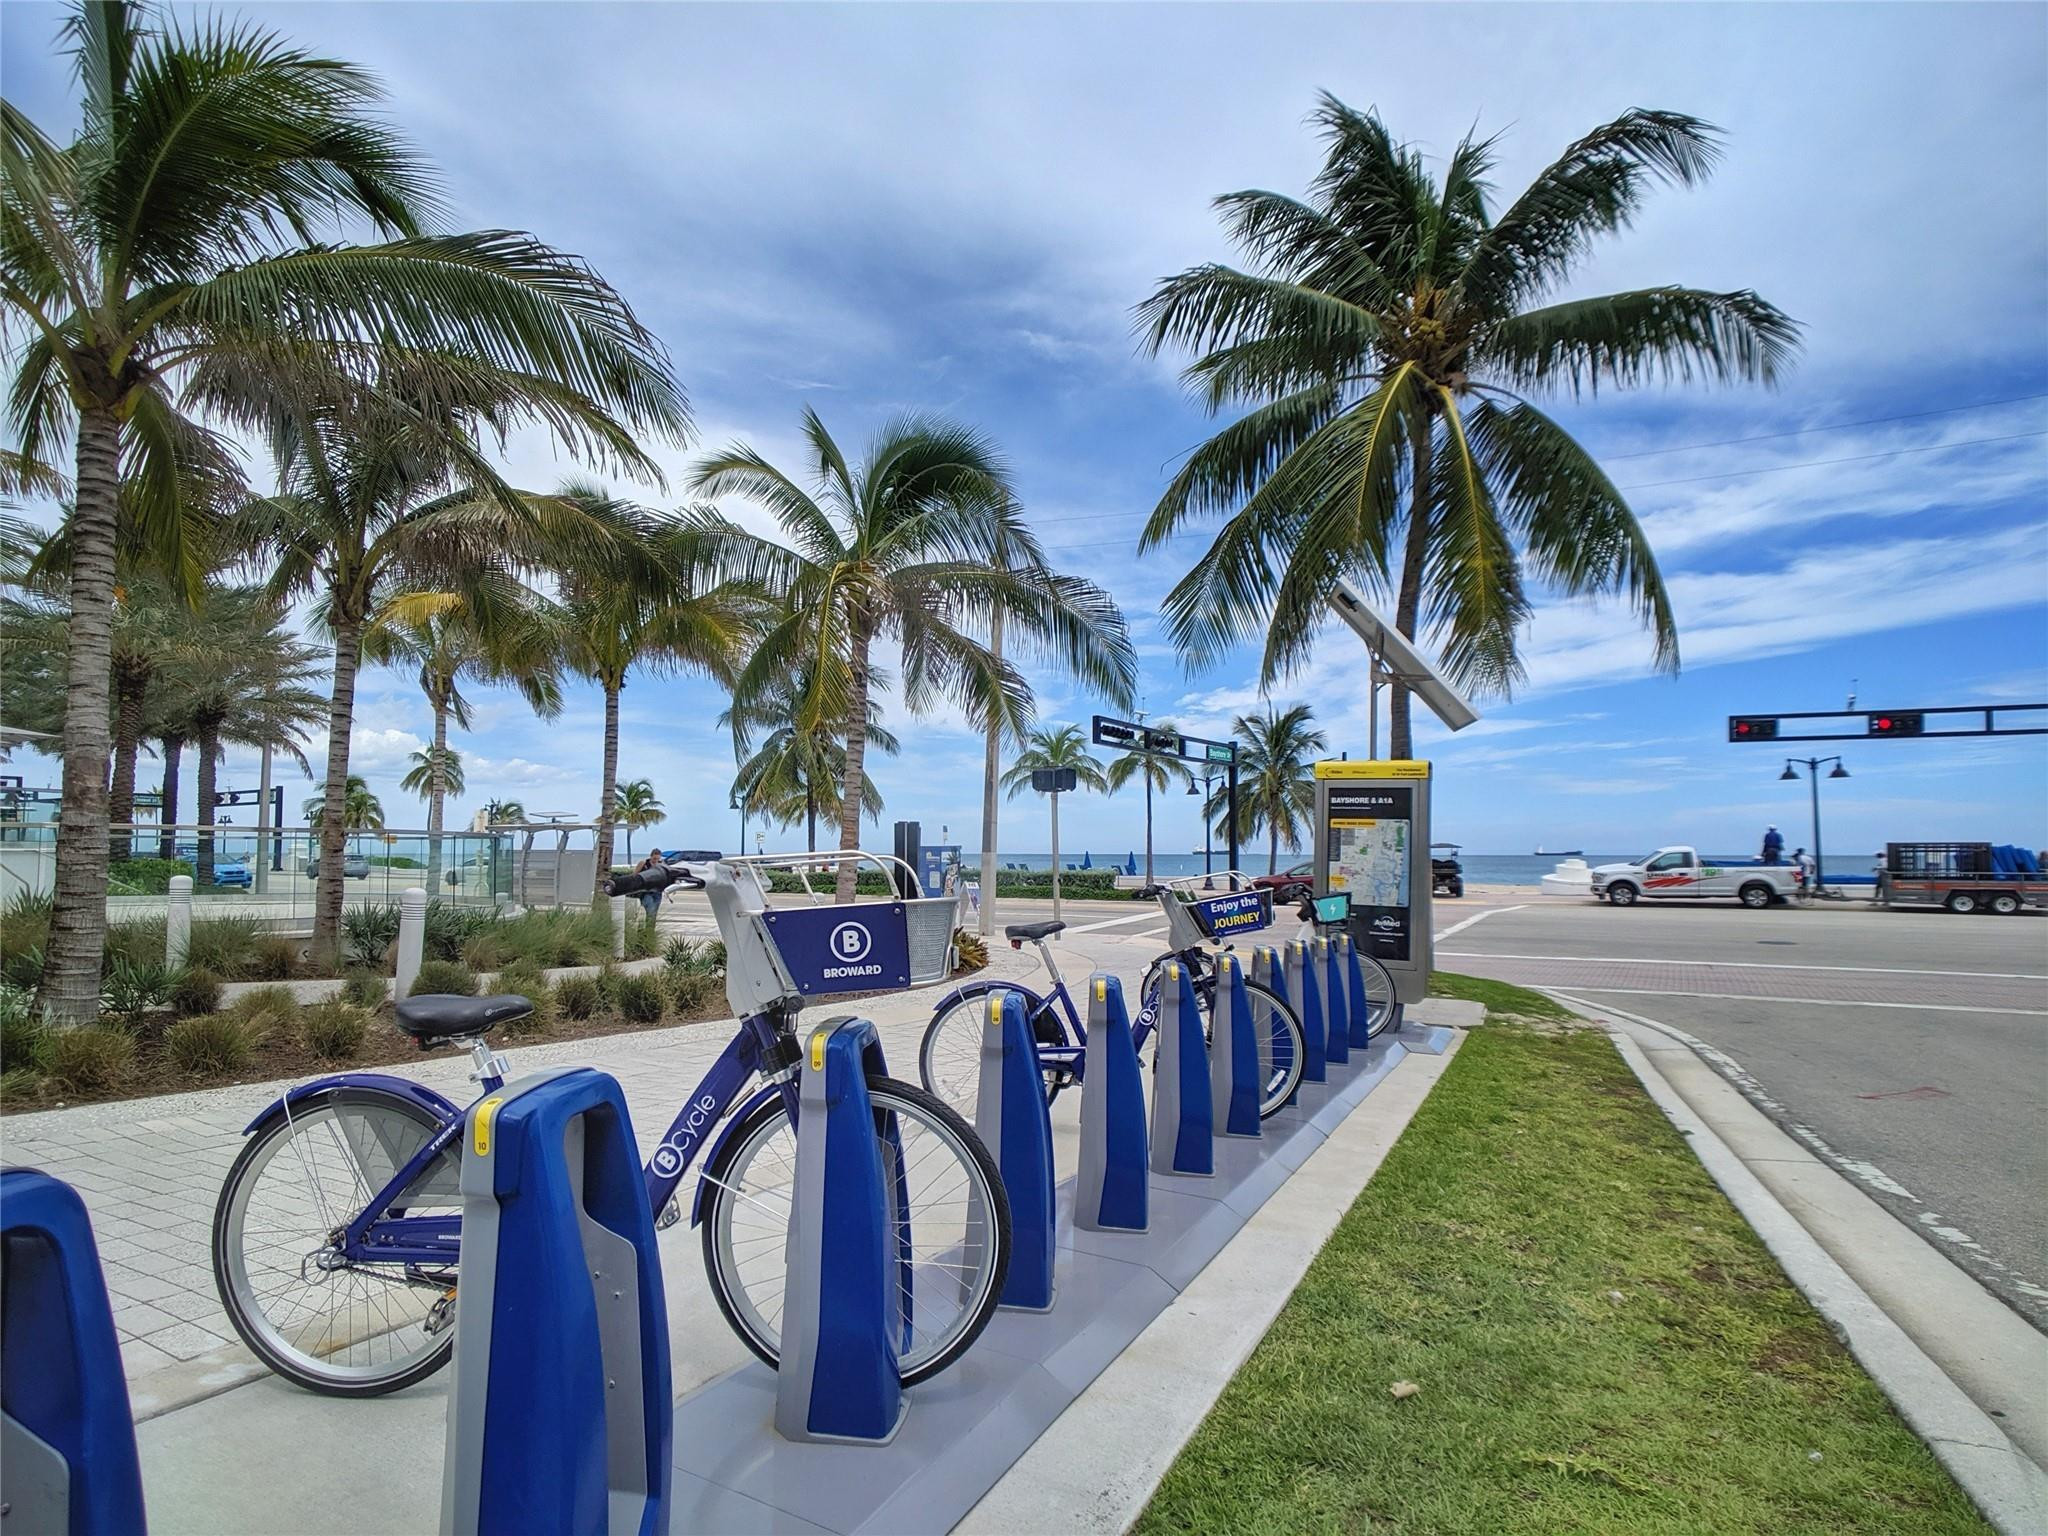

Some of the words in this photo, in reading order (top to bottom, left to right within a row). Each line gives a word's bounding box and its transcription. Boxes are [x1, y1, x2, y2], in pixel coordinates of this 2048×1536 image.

[1210, 900, 1239, 914] Enjoy
[1240, 897, 1258, 908] the
[1214, 912, 1260, 929] JOURNEY
[823, 964, 882, 979] BROWARD
[429, 1123, 457, 1151] TREK
[478, 1142, 487, 1151] 10
